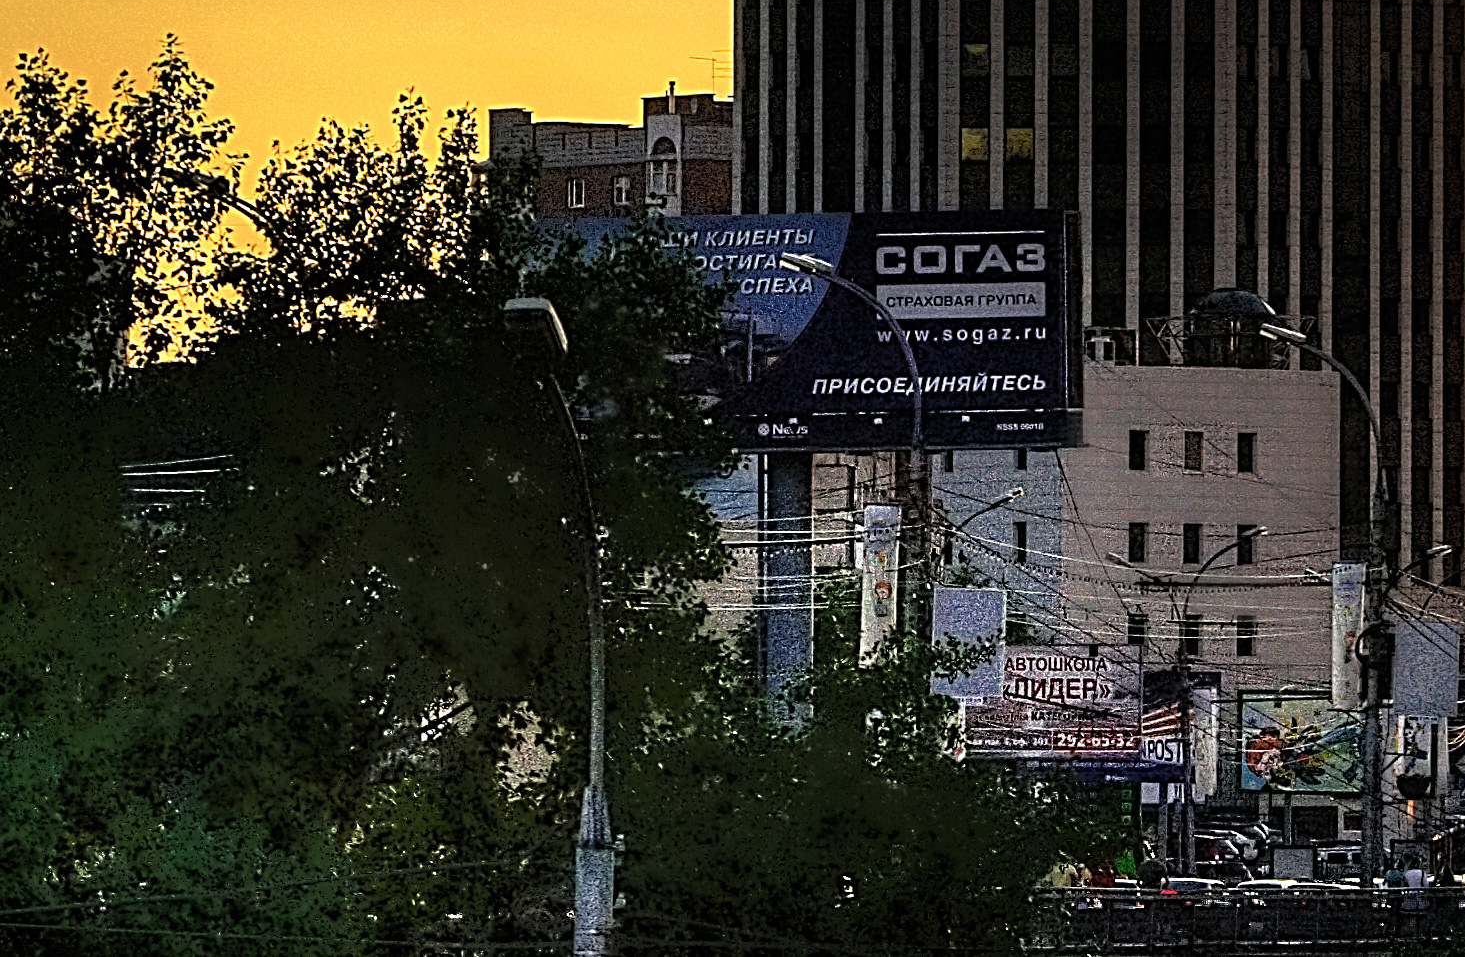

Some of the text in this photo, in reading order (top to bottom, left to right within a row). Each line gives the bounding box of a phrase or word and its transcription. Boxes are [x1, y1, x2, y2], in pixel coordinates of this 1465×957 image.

[705, 229, 815, 247] КЛИЕНТЫ
[876, 243, 1047, 275] СОГАЗ
[740, 277, 814, 294] СПЕХА
[886, 293, 1037, 308] СТРАХОВАЯ ГРУППА
[812, 373, 1047, 396] ПРИСОЕДИНЯЙТЕСЬ
[1004, 657, 1107, 672] АВТОШКОЛА
